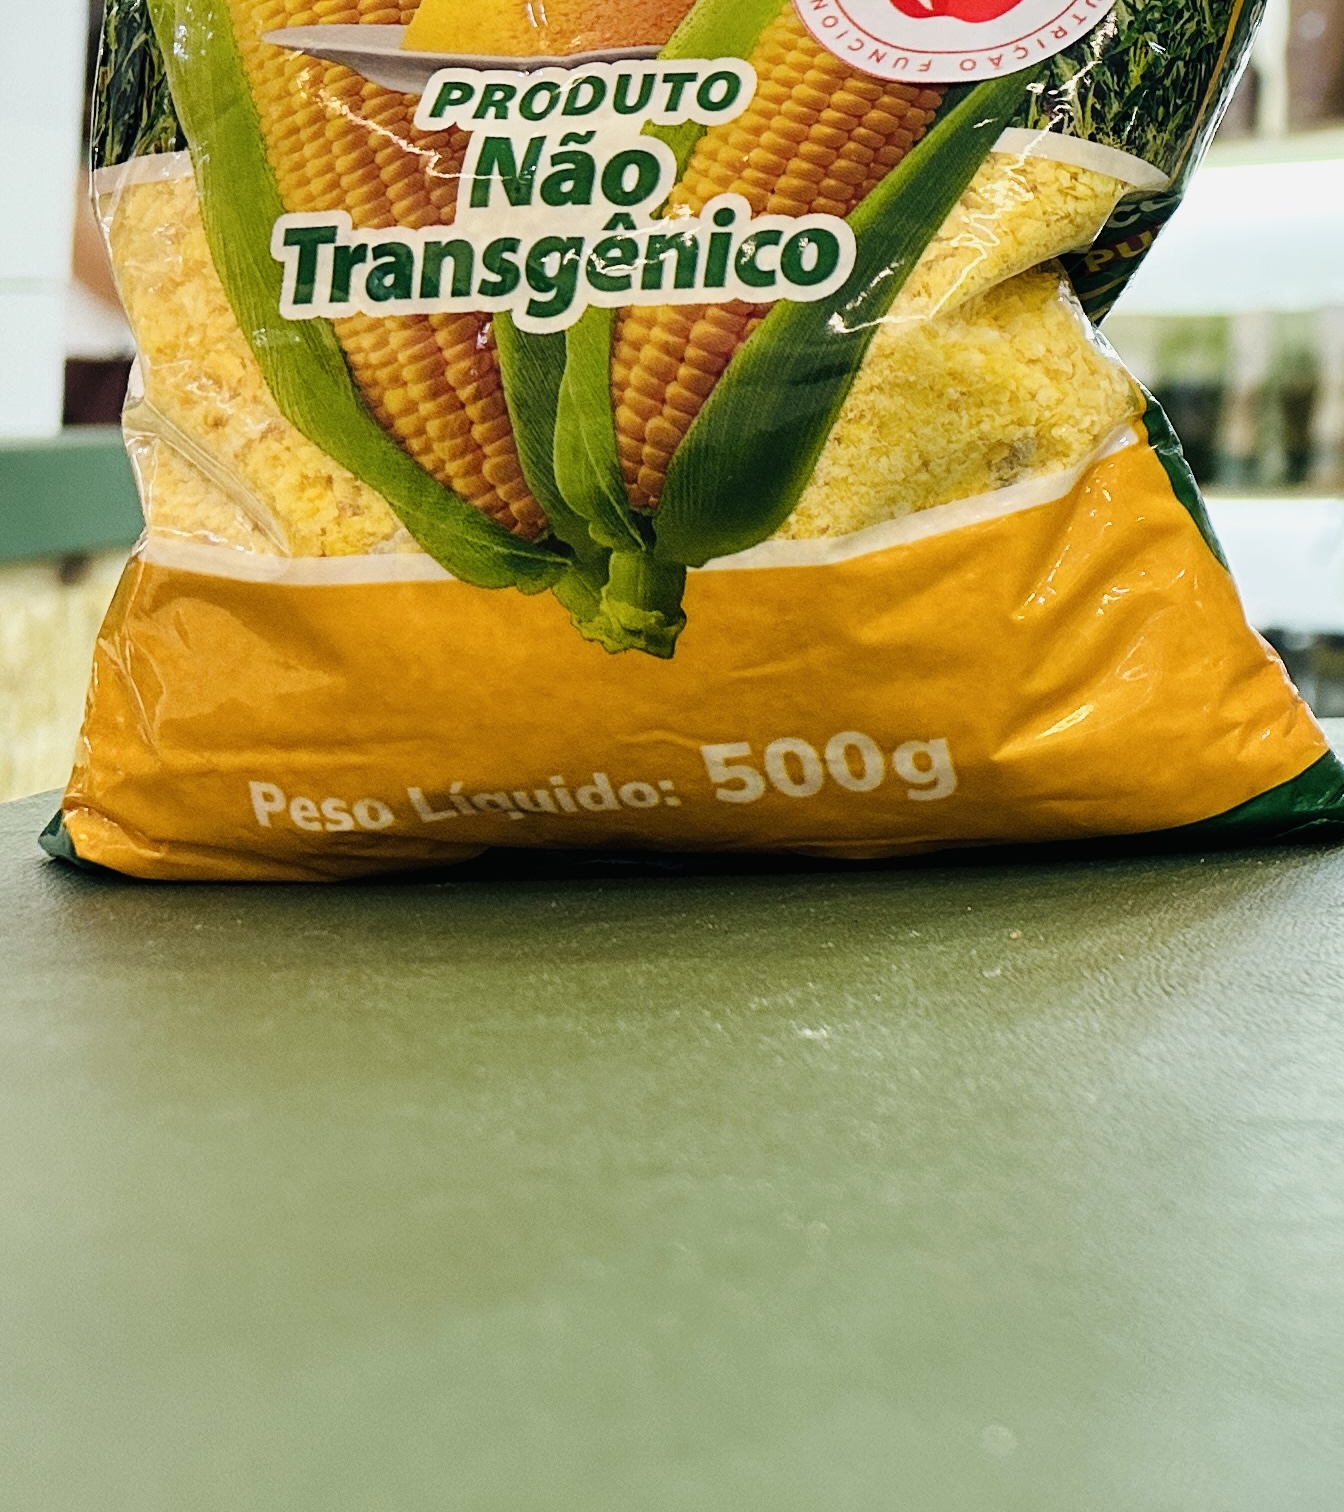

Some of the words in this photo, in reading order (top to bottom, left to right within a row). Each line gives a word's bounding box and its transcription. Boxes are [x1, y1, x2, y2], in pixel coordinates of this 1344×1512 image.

[430, 70, 743, 122] PRODUTO
[470, 129, 662, 208] Não
[284, 207, 842, 318] Transgênico
[249, 779, 392, 834] Peso
[408, 771, 683, 826] Líquido:
[701, 729, 960, 809] 500g
